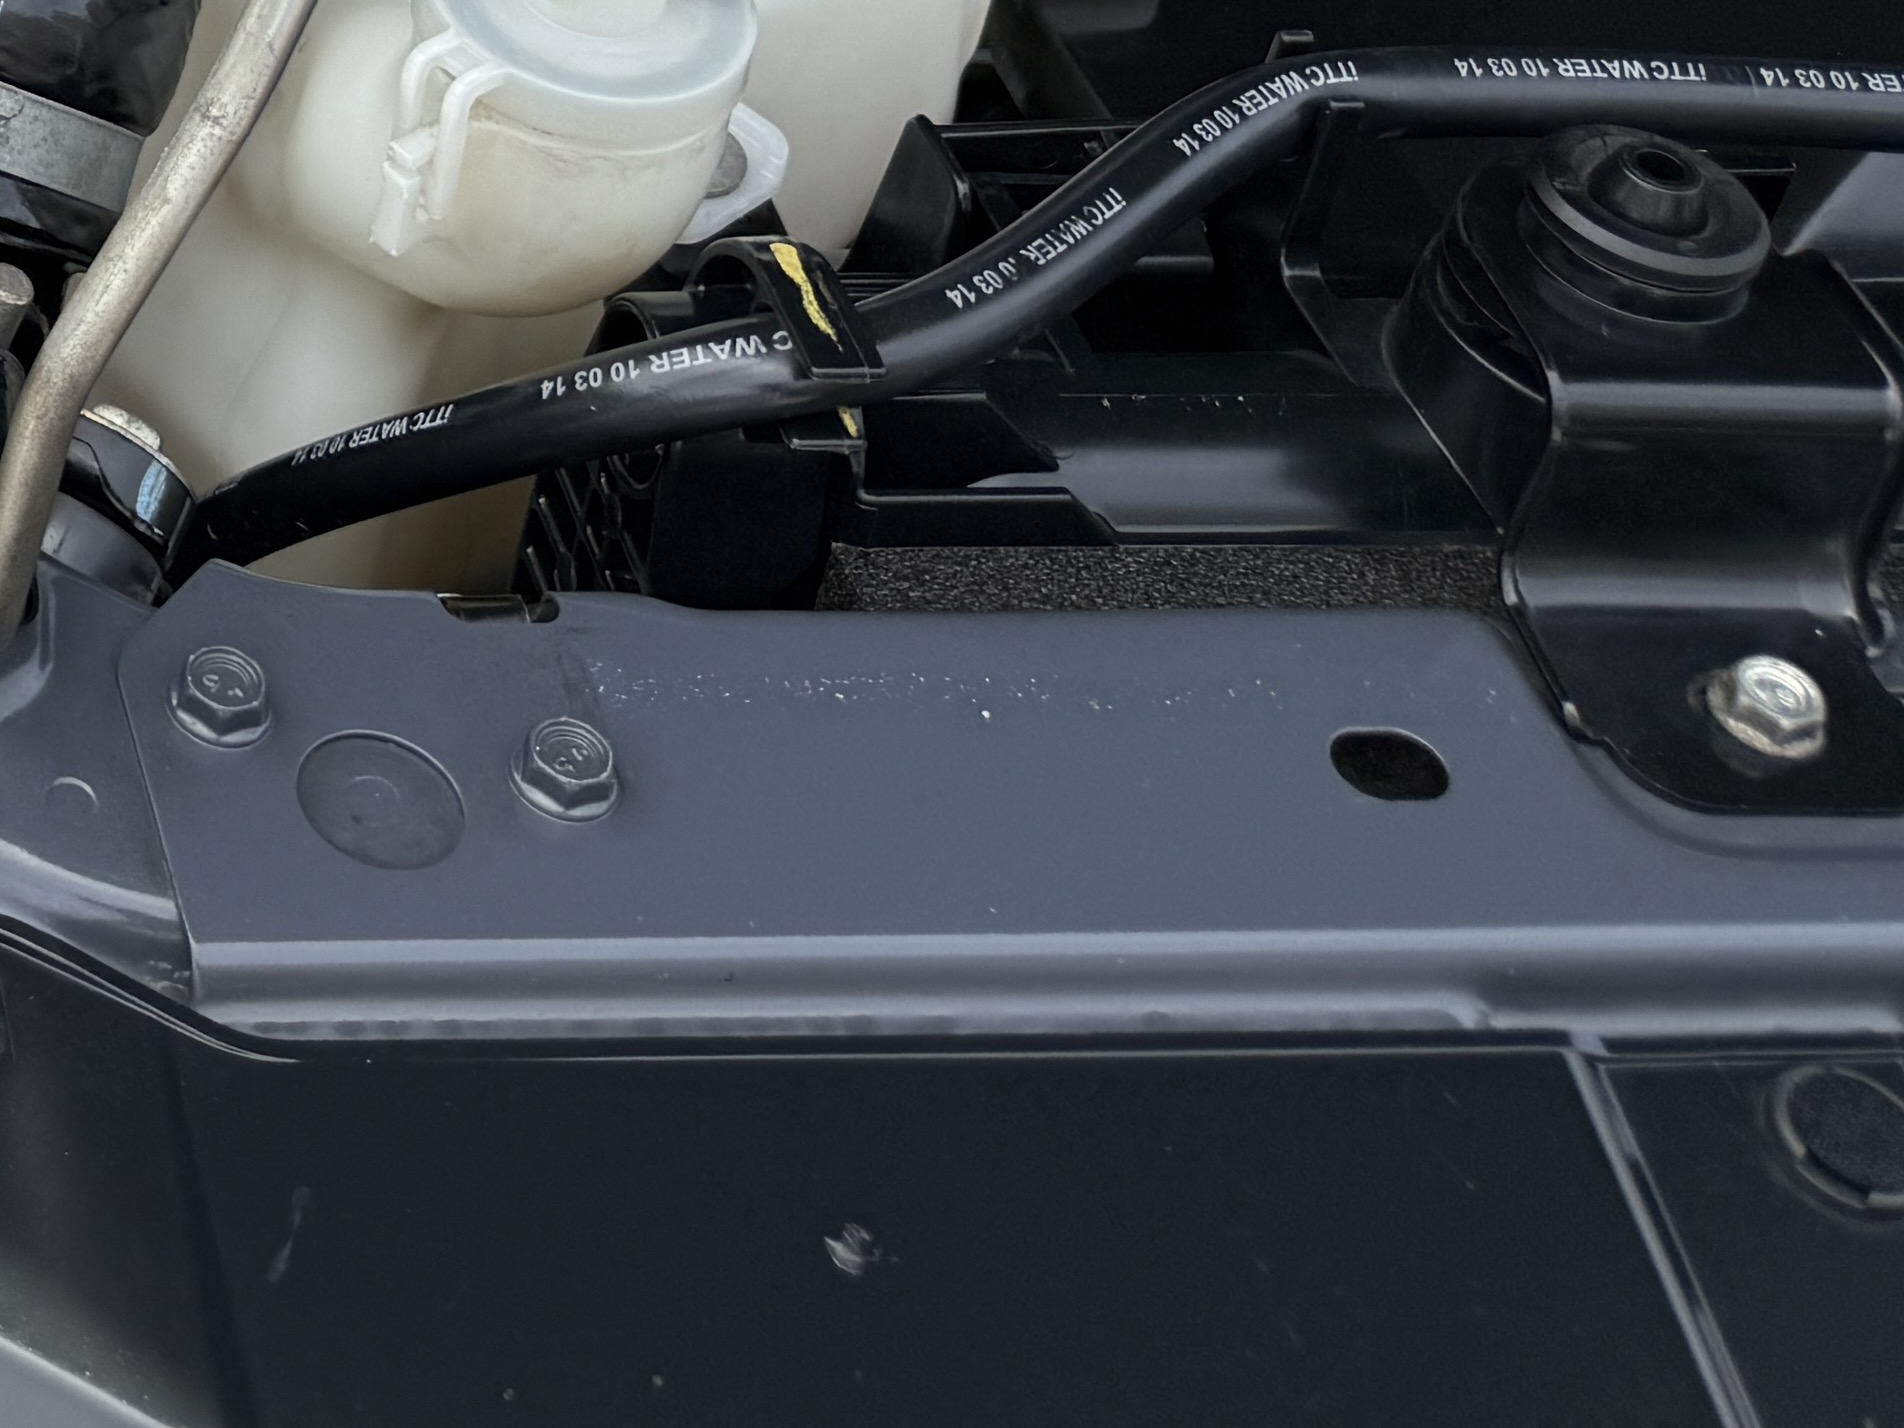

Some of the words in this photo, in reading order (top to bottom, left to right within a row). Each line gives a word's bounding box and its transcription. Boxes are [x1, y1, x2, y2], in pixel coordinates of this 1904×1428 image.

[1453, 58, 1483, 77] 14
[1487, 58, 1518, 77] 03
[1521, 58, 1550, 77] 10
[1552, 58, 1649, 80] WATER
[1760, 67, 1789, 87] 14
[1794, 68, 1825, 88] 03
[1829, 70, 1859, 90] 10
[1232, 71, 1309, 116] WATER
[1213, 105, 1240, 129] 10
[1193, 118, 1221, 141] 03
[1173, 133, 1200, 157] 14
[1019, 215, 1093, 265] WATER
[972, 269, 1003, 294] 03
[945, 284, 975, 309] 14
[648, 334, 768, 373] WATER
[573, 367, 603, 392] 03
[610, 359, 640, 382] 10
[540, 376, 566, 400] 14
[349, 416, 408, 448] WATER
